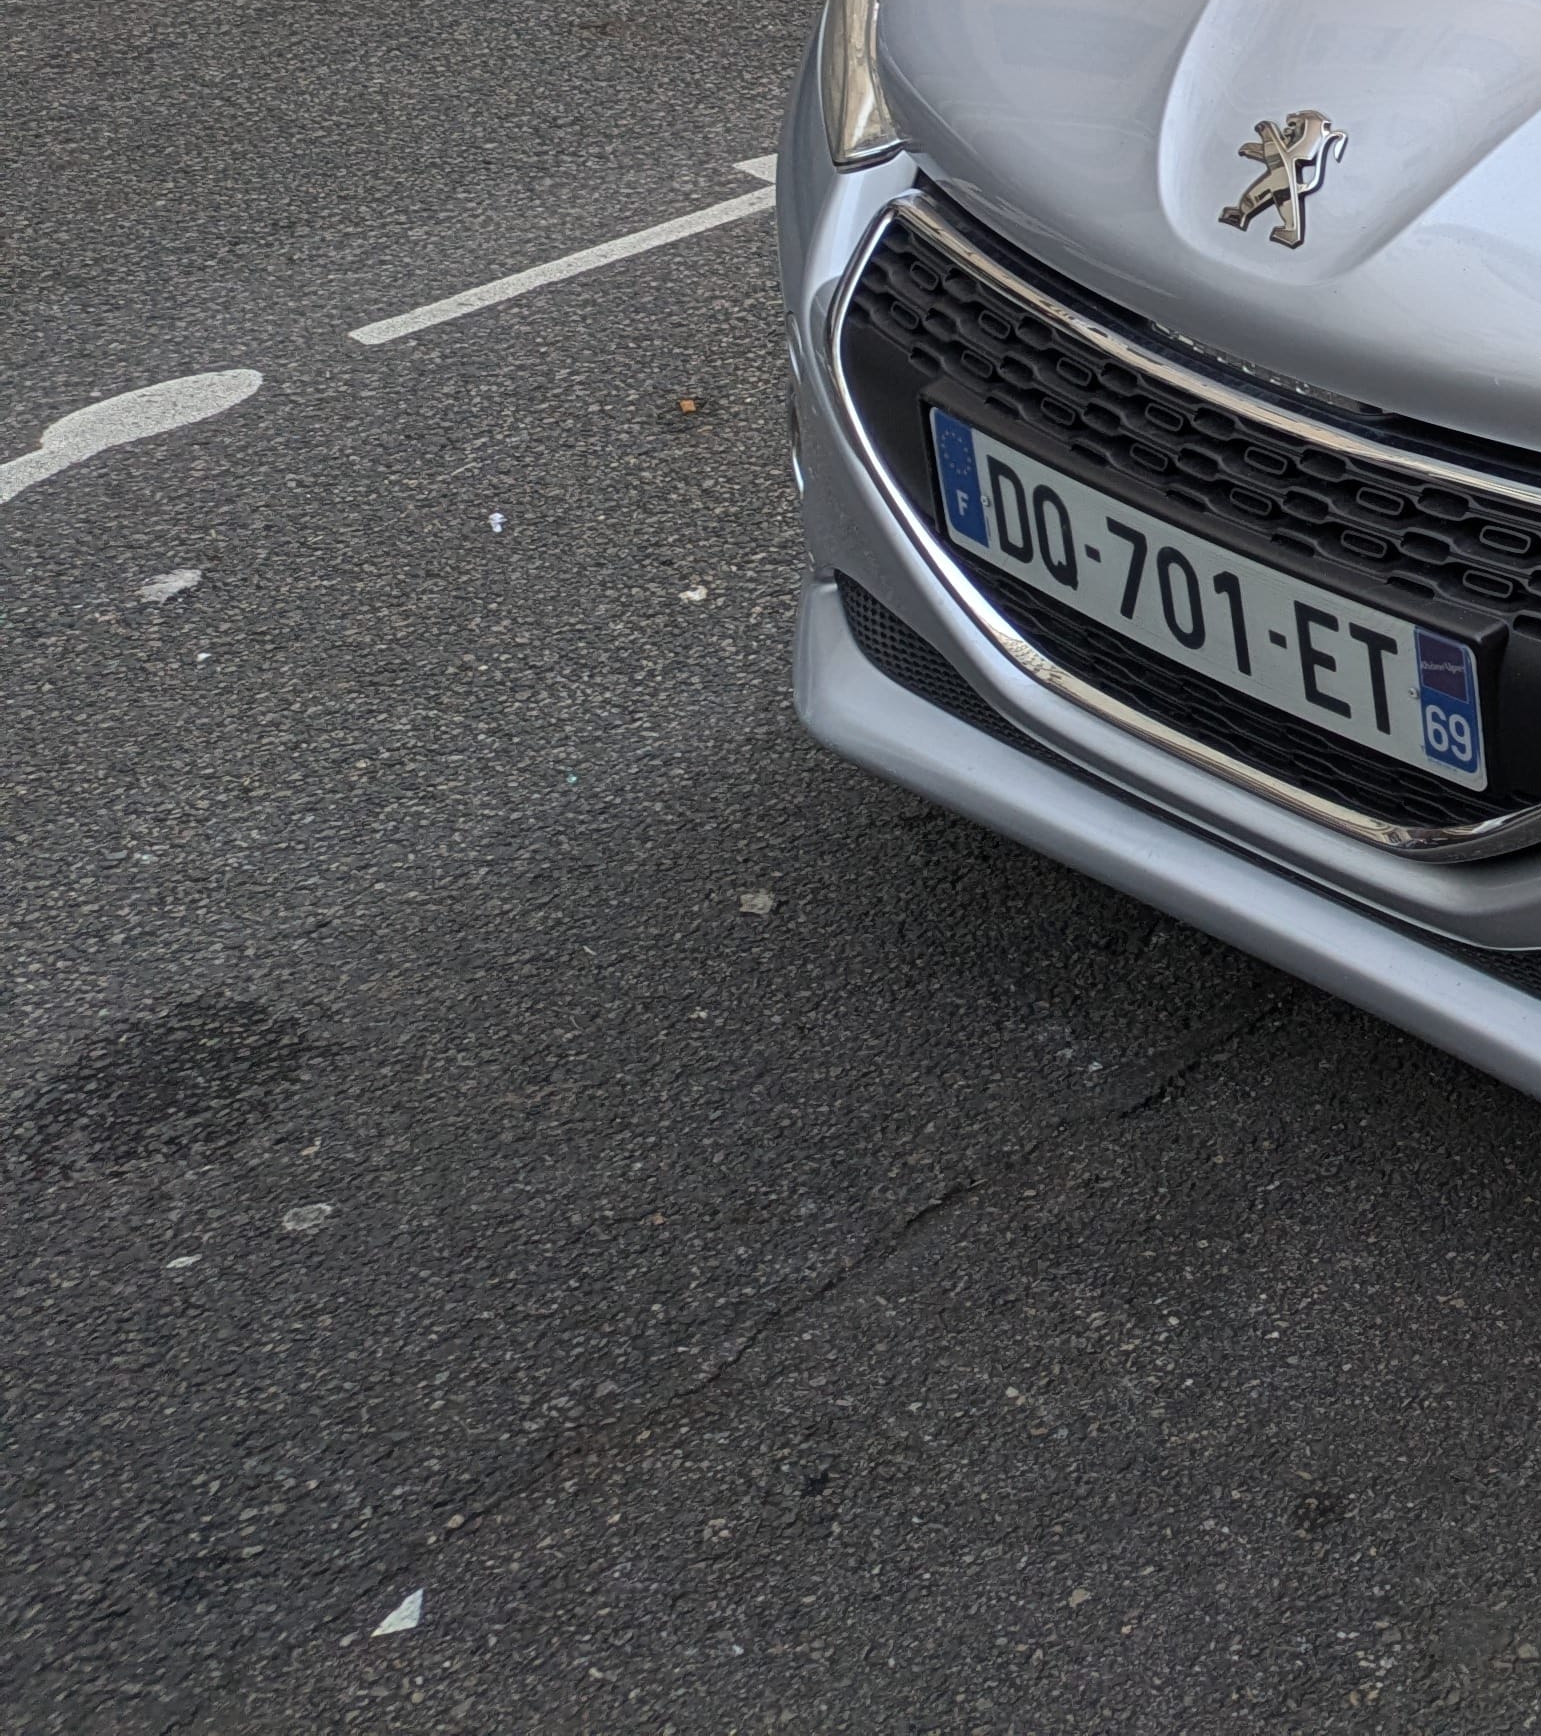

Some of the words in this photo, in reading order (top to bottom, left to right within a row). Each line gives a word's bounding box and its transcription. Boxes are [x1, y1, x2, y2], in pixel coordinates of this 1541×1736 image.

[956, 489, 969, 517] F
[987, 454, 1399, 736] DQ-701-ET
[1425, 704, 1473, 763] 69
